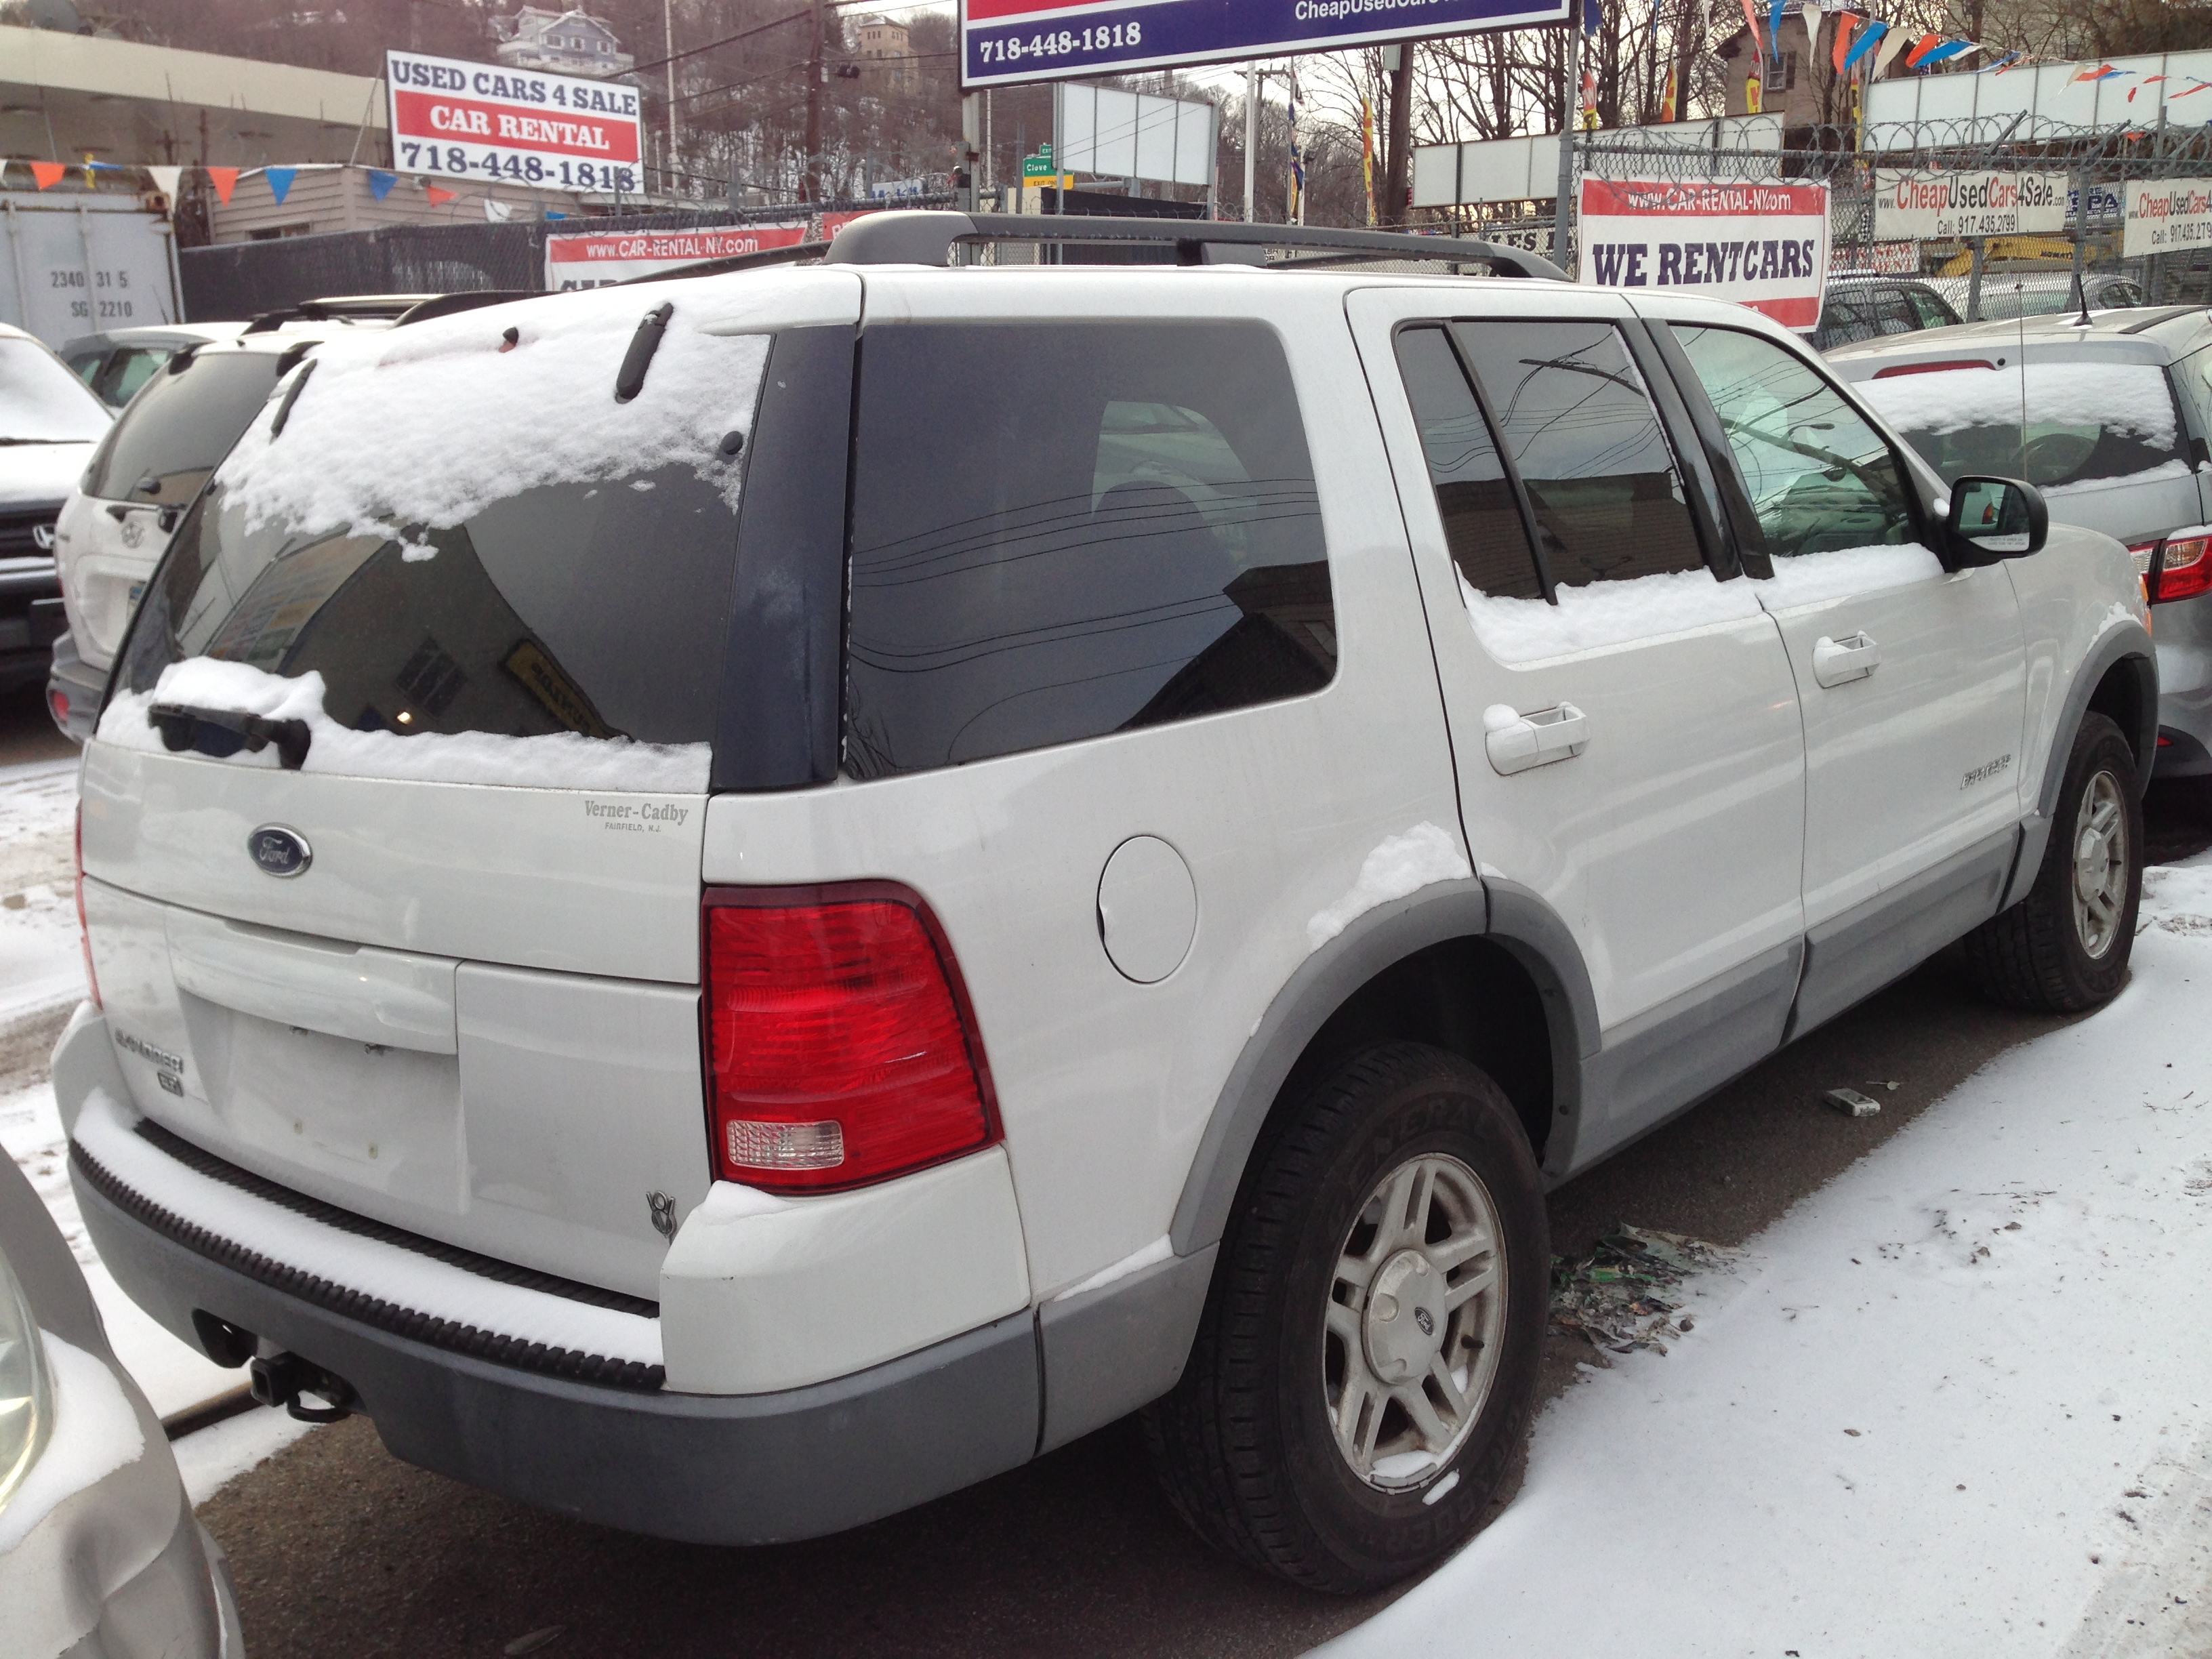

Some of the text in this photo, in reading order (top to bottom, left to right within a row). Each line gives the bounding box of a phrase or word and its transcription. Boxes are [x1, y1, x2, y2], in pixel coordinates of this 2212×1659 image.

[980, 21, 1142, 63] 718-448-1818
[391, 60, 636, 116] USED CARS 4 SALE
[430, 105, 609, 150] CAR RENTAL
[401, 141, 635, 192] 718-448-1818
[1938, 220, 1956, 234] Call:
[2152, 229, 2167, 245] Call:
[51, 270, 128, 289] 2340 31 5
[1593, 243, 1648, 287] WE
[70, 300, 133, 318] SG 2210
[585, 800, 689, 826] Verner-Cadby
